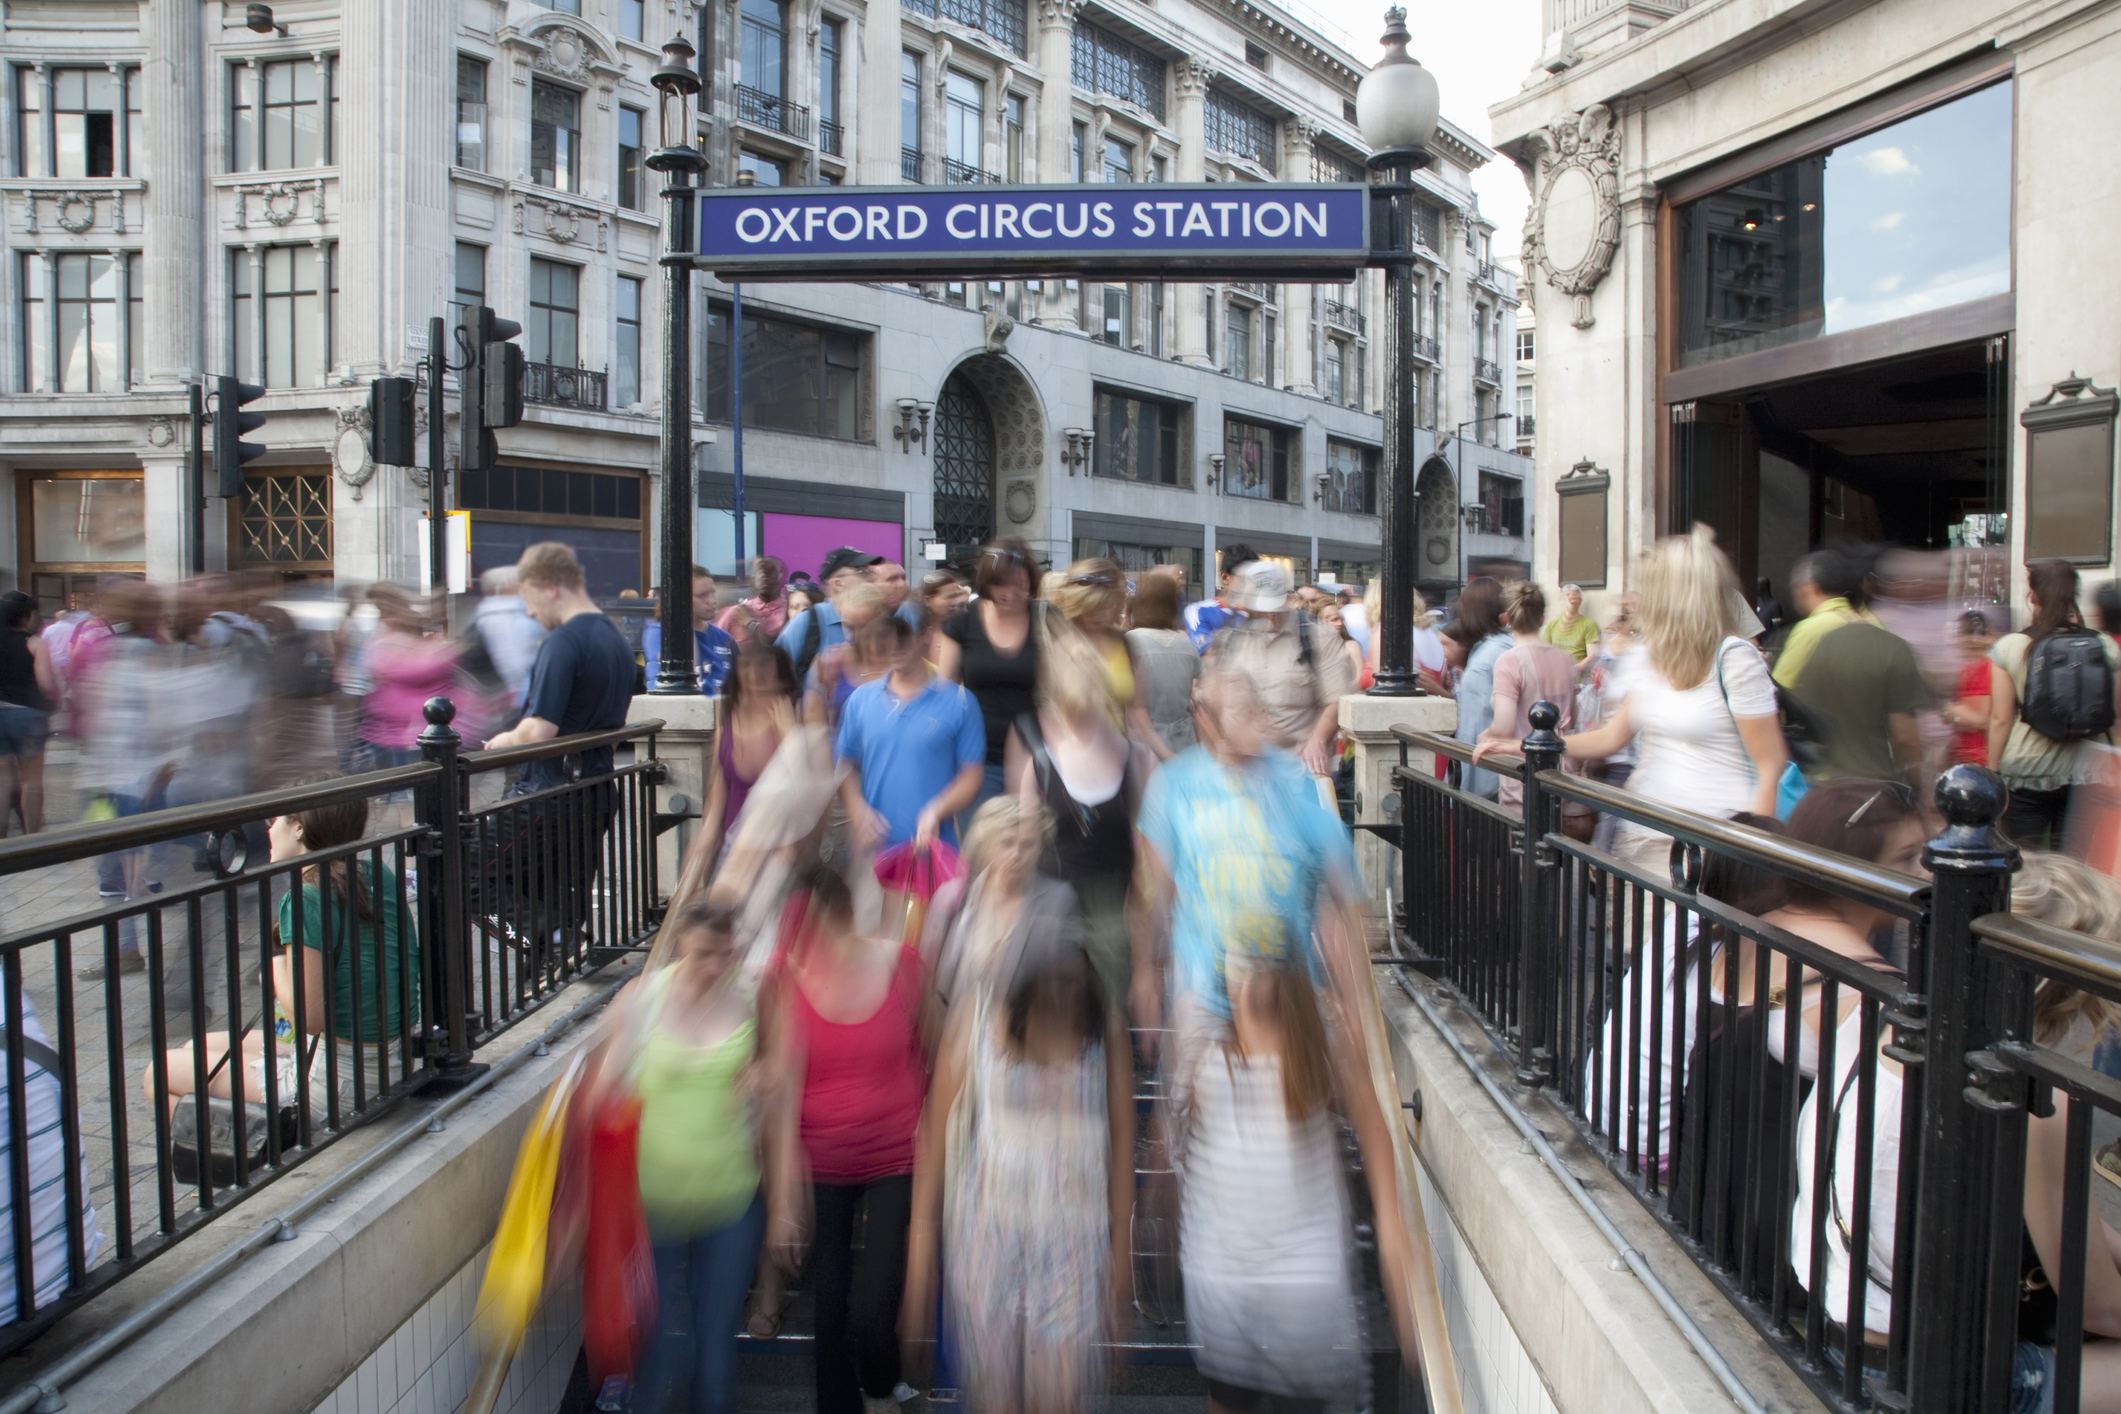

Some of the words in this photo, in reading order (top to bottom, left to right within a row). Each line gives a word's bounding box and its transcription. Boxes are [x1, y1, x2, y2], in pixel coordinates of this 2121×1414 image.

[735, 205, 928, 243] OXFORD
[945, 202, 1116, 239] CIRCUS
[1131, 202, 1327, 238] STATION
[410, 328, 428, 336] OXFO
[410, 335, 428, 344] STREE
